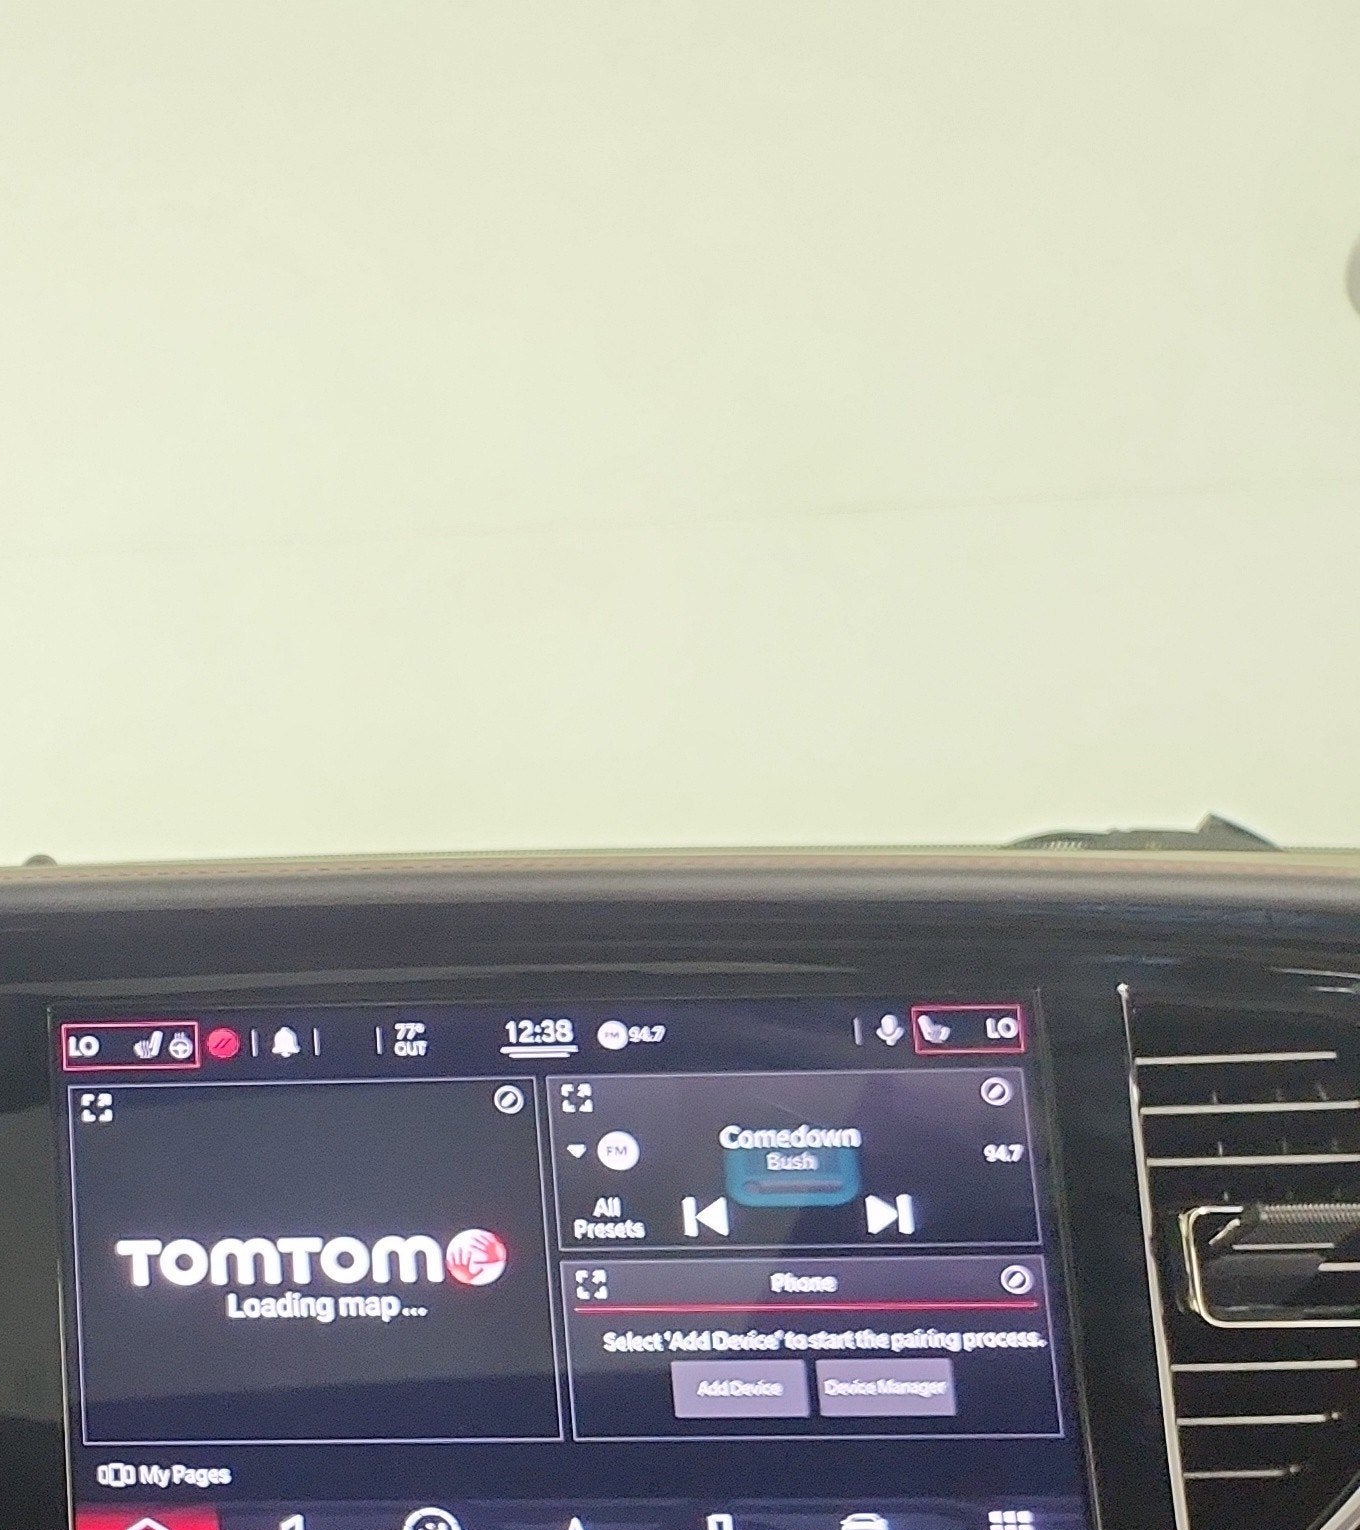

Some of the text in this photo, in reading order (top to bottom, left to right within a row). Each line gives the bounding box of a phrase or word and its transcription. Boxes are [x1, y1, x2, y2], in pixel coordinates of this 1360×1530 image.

[505, 1019, 574, 1043] 12:38
[986, 1017, 1018, 1039] LO
[69, 1036, 100, 1057] LO
[394, 1041, 427, 1057] OUT
[719, 1125, 862, 1150] Comedown
[766, 1152, 818, 1172] Bush
[983, 1144, 1023, 1164] 94.7
[593, 1197, 622, 1218] All
[574, 1219, 646, 1240] Presets
[771, 1273, 839, 1294] Phone
[228, 1294, 335, 1323] Loading
[602, 1331, 665, 1352] Select
[784, 1331, 808, 1350] to
[808, 1330, 855, 1350] start
[855, 1329, 890, 1350] the
[890, 1328, 962, 1352] pairing
[963, 1331, 1048, 1352] process.
[696, 1380, 784, 1397] Add Device
[824, 1379, 947, 1398] Device Manager
[140, 1465, 232, 1488] My Pages
